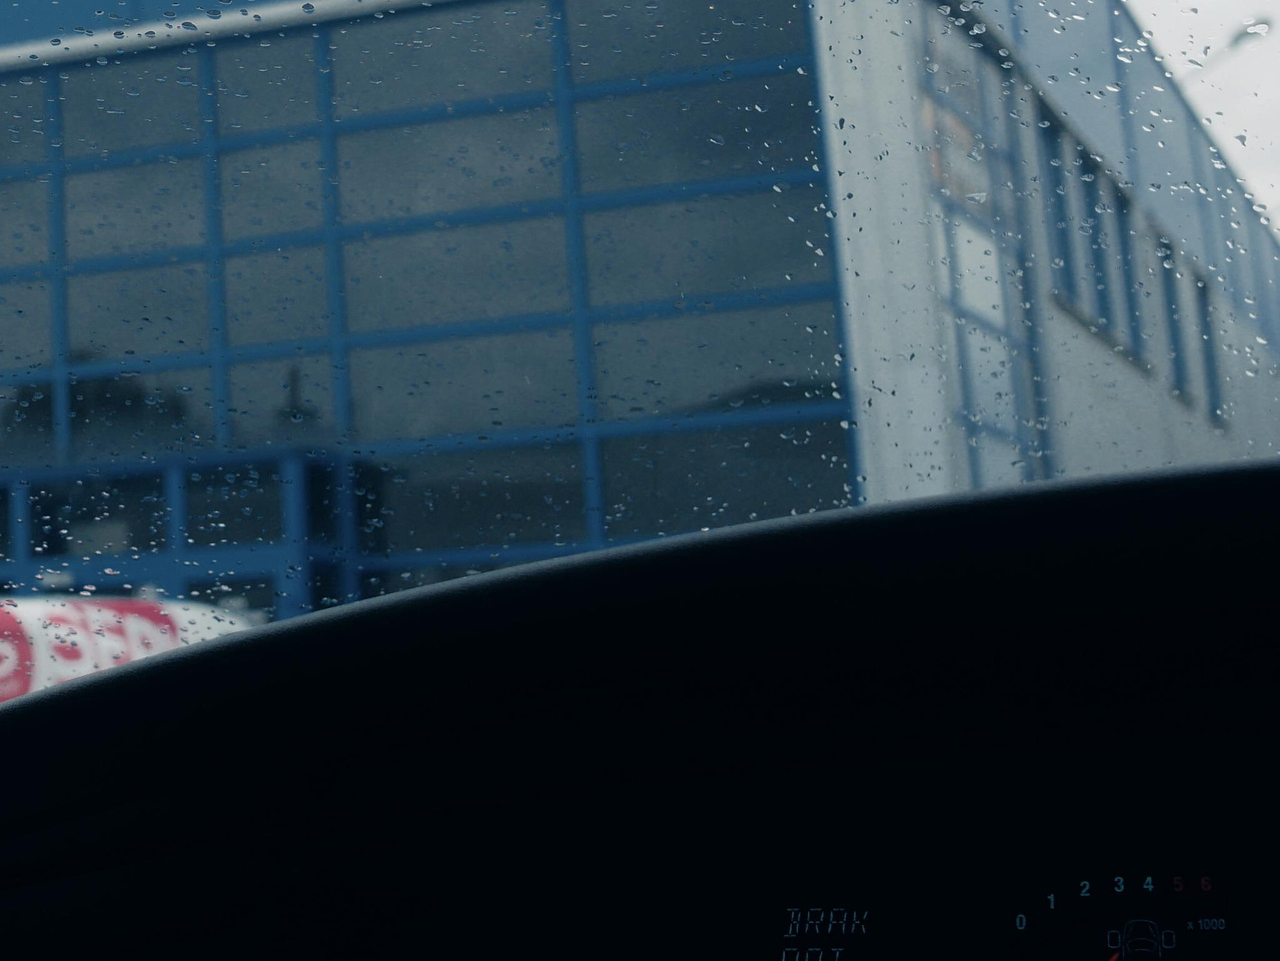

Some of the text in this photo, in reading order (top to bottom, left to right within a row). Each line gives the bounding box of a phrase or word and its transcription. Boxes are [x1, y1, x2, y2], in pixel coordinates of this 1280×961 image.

[1015, 914, 1027, 930] 0
[1047, 893, 1056, 909] 1
[1079, 881, 1091, 897] 2
[1113, 876, 1125, 892] 3
[1142, 876, 1154, 892] 4
[1172, 876, 1184, 892] 5
[783, 908, 869, 937] BRAK
[1198, 918, 1226, 930] 1000
